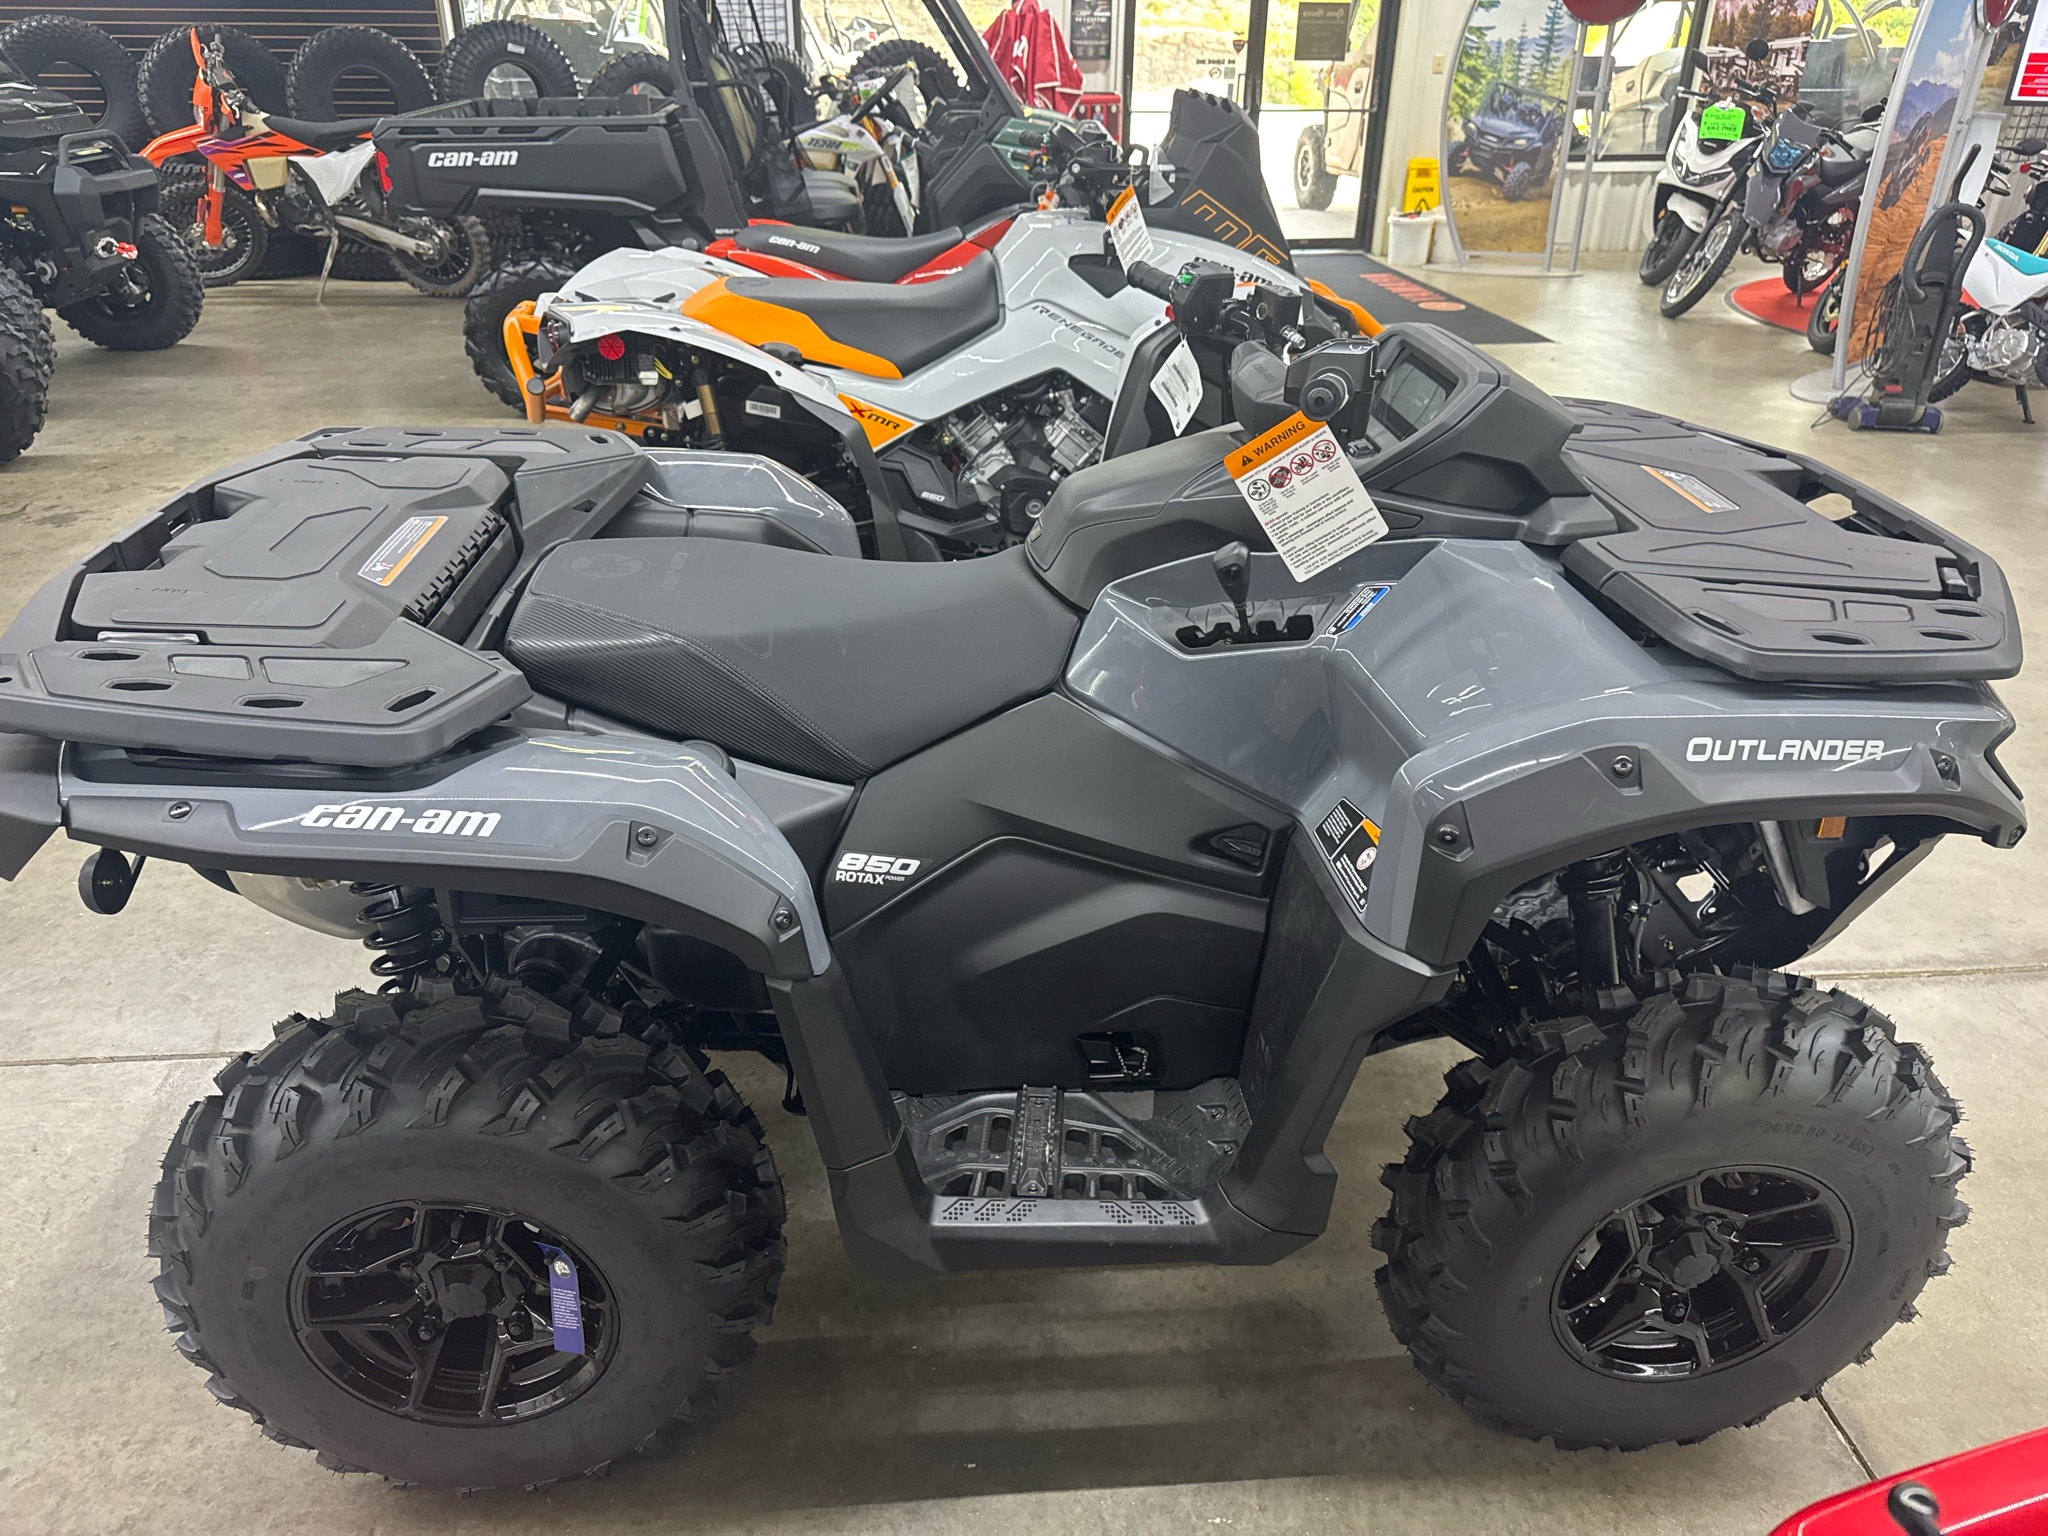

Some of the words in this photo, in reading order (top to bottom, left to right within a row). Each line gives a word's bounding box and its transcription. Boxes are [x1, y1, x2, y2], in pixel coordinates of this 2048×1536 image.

[428, 151, 518, 167] can-am
[768, 235, 820, 254] can-am
[1031, 305, 1126, 359] RENEGADE
[1252, 420, 1306, 456] WARNING
[1686, 736, 1885, 762] OUTLANDER
[300, 805, 502, 837] can-am
[838, 852, 921, 876] 850
[835, 870, 885, 885] ROTAX
[884, 874, 905, 882] POWER
